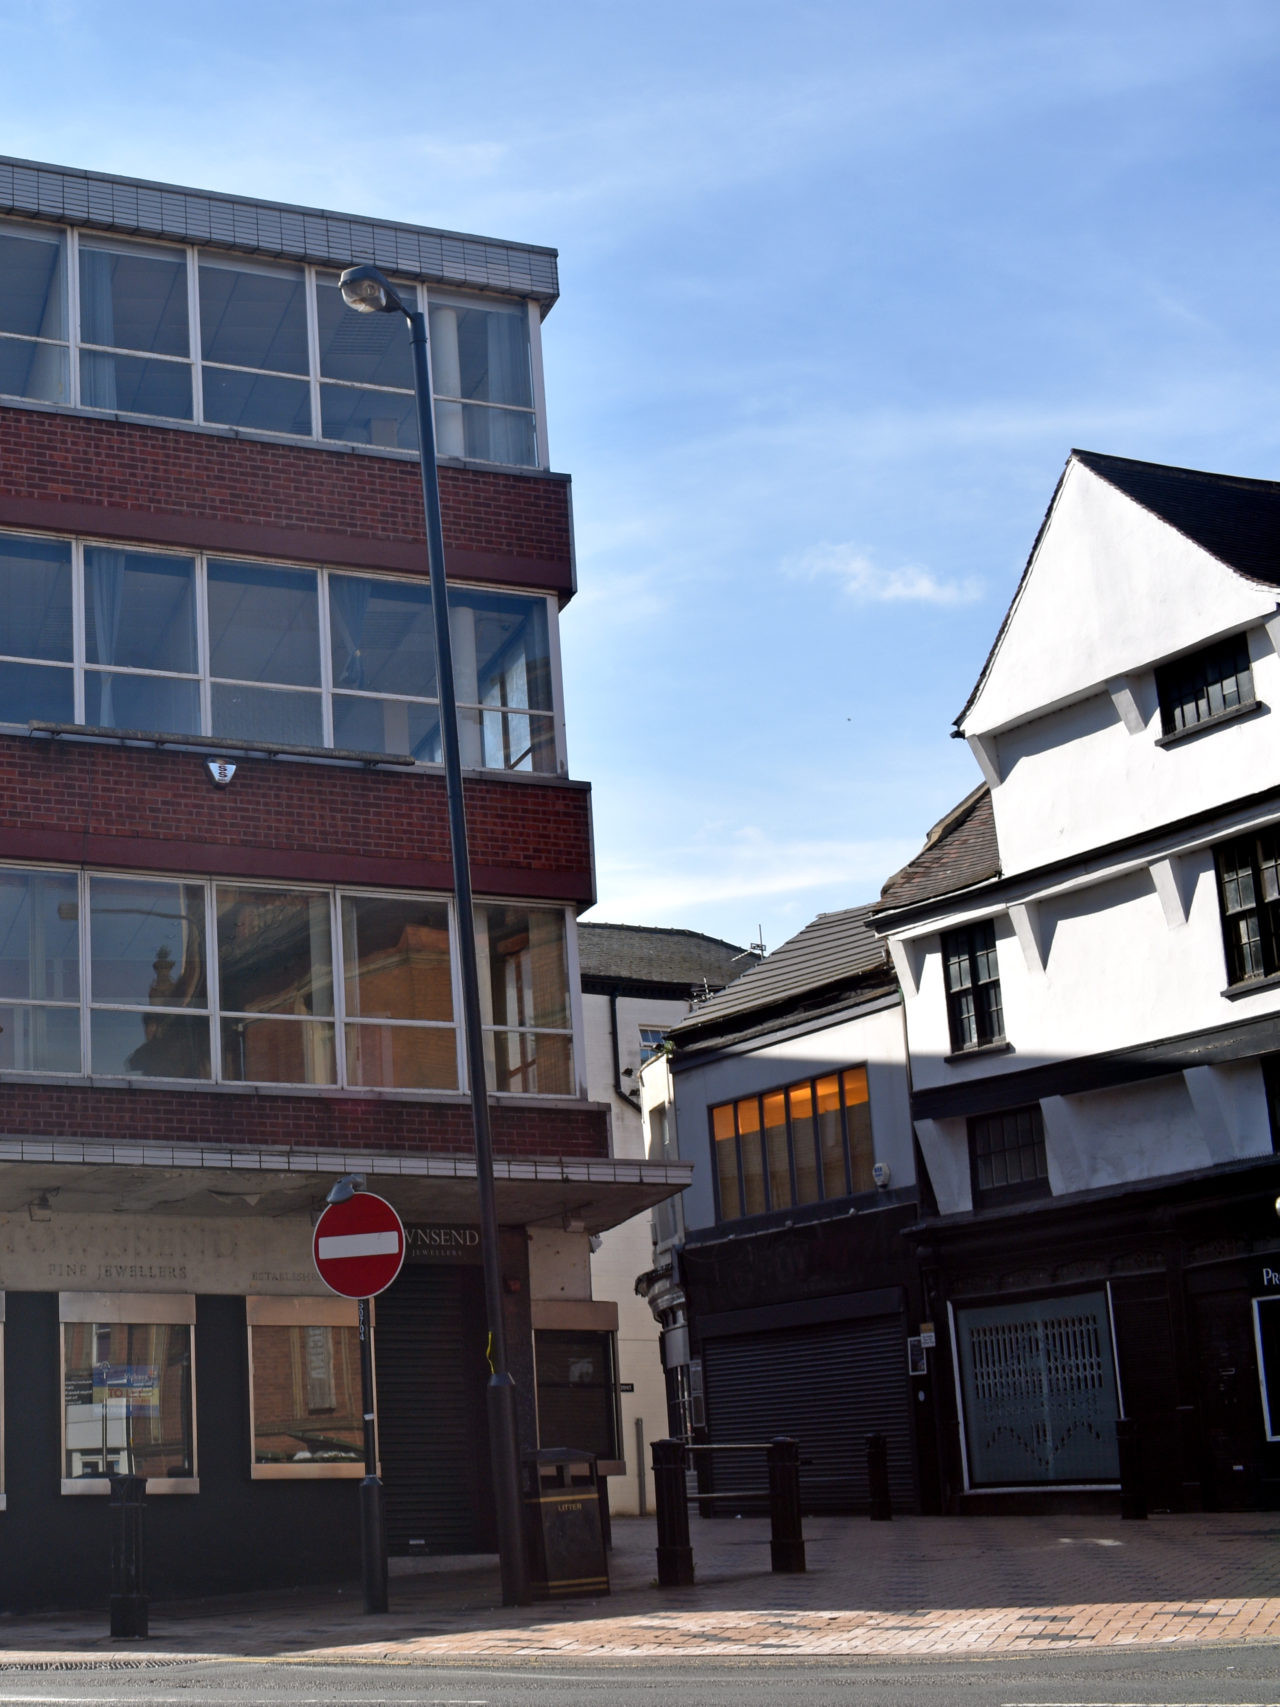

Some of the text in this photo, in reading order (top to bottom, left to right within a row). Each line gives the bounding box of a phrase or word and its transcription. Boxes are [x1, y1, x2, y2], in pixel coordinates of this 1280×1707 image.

[48, 1263, 187, 1280] FINE JEWELLERS
[1262, 1267, 1280, 1286] PR
[558, 1503, 582, 1512] LITTER
